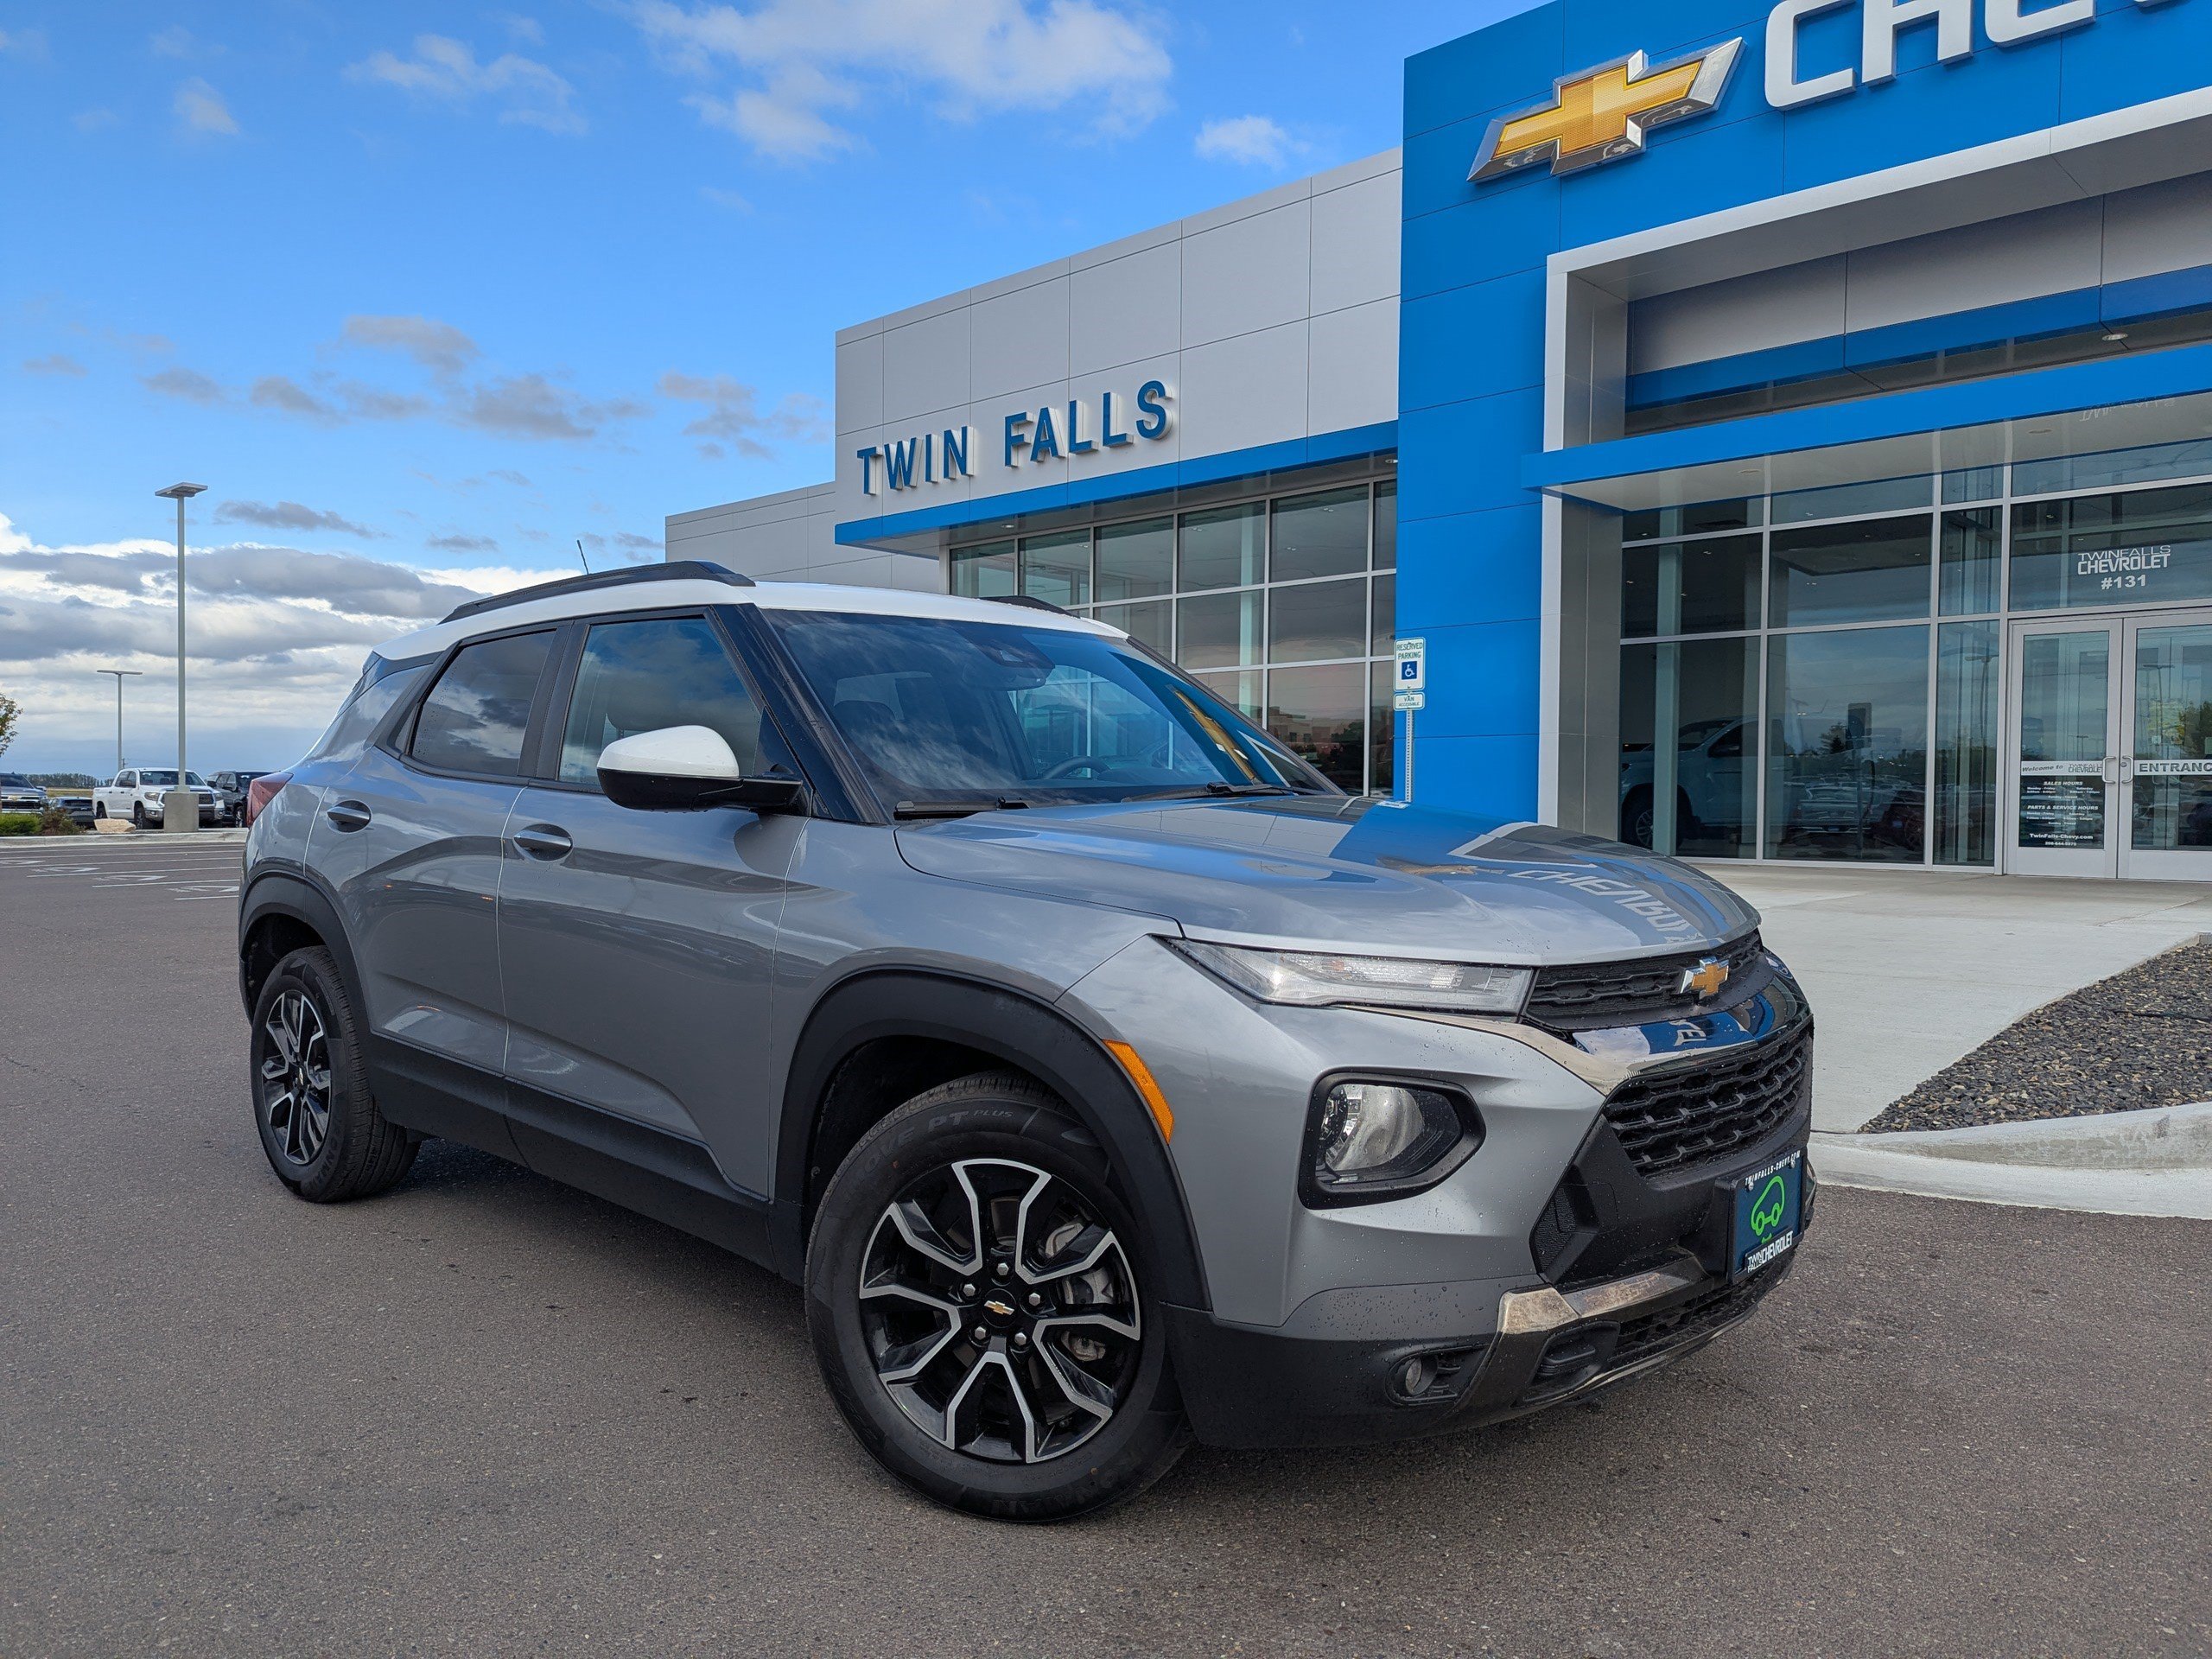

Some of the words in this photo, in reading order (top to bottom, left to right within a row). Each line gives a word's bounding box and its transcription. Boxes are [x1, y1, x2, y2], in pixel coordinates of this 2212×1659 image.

[857, 426, 974, 495] TWIN
[1005, 380, 1173, 468] FALLS
[2077, 554, 2171, 575] CHEVROLET
[2101, 575, 2146, 590] #131
[1396, 642, 1423, 652] RESERVED
[1398, 652, 1421, 660] PARKING
[973, 1109, 1014, 1119] PLUS
[1761, 1230, 1794, 1265] CHEVROLET
